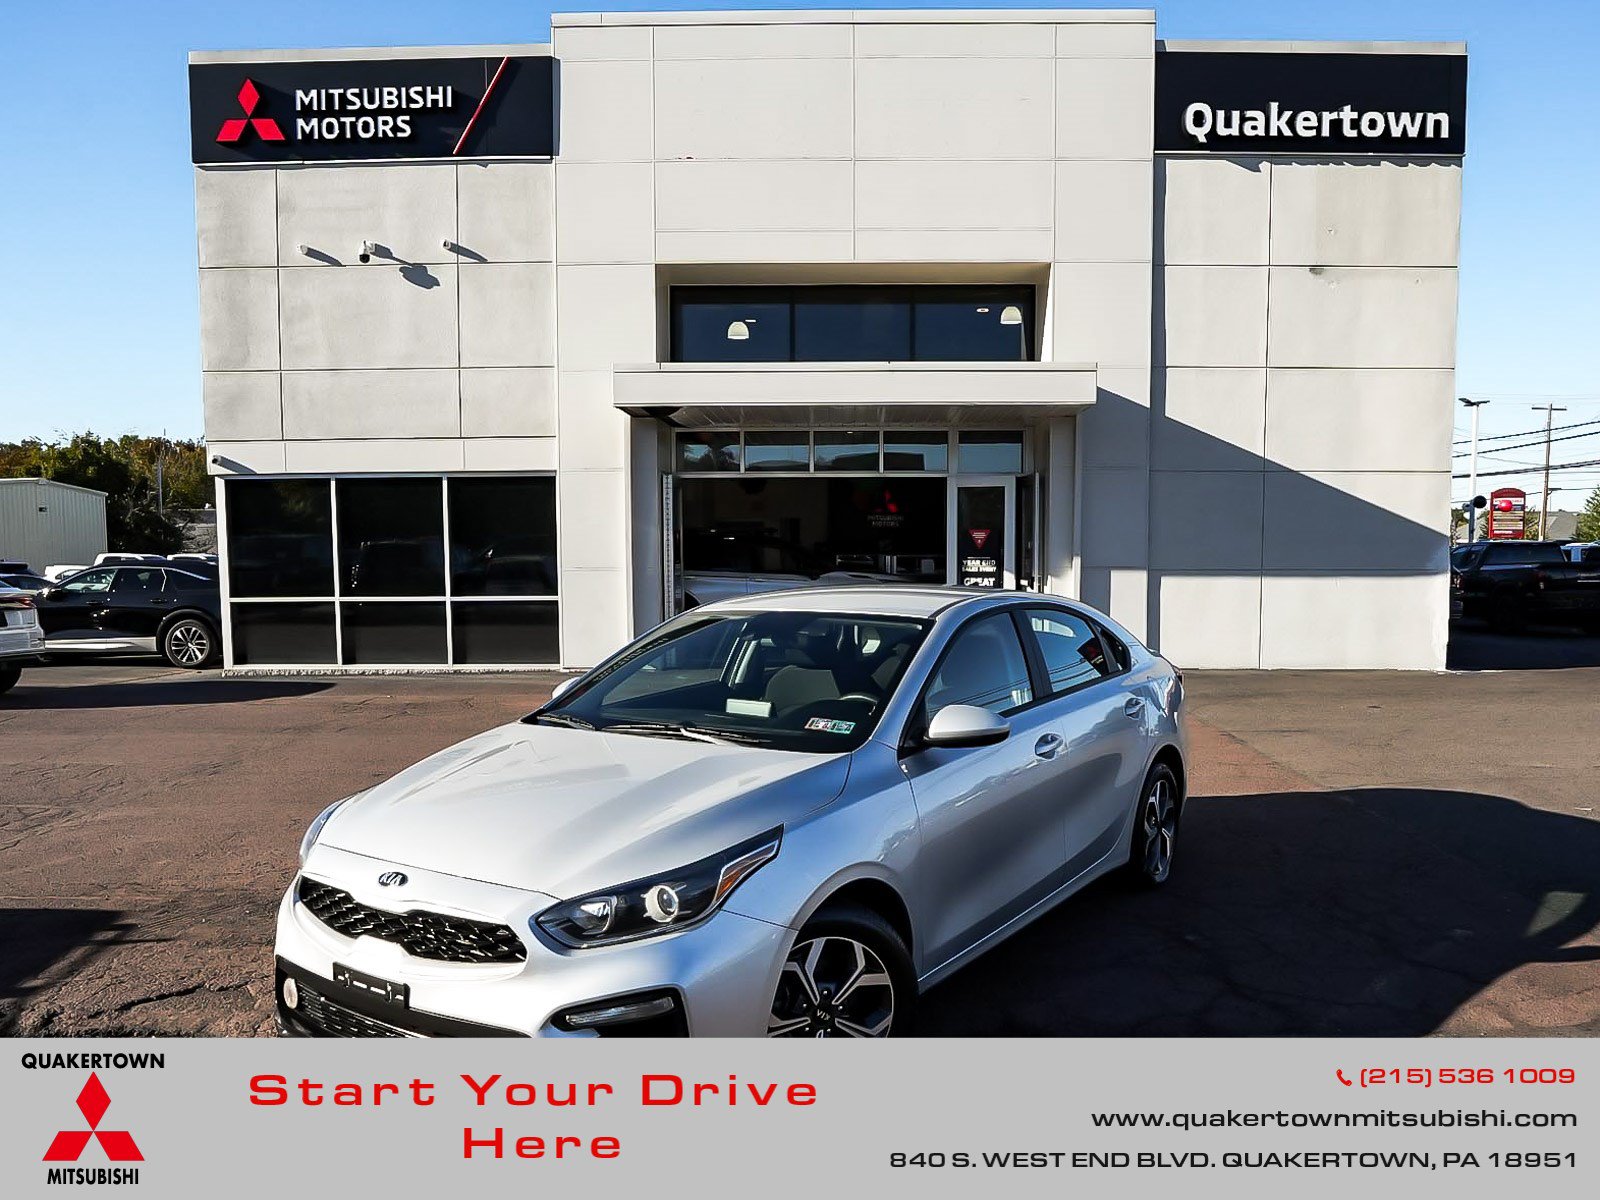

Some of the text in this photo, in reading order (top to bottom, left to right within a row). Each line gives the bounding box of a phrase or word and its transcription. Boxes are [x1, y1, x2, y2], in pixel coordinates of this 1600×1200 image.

[295, 86, 453, 111] MITSUBISHI
[296, 116, 412, 140] MOTORS
[1184, 101, 1450, 143] Quakertown
[379, 873, 403, 886] KIA
